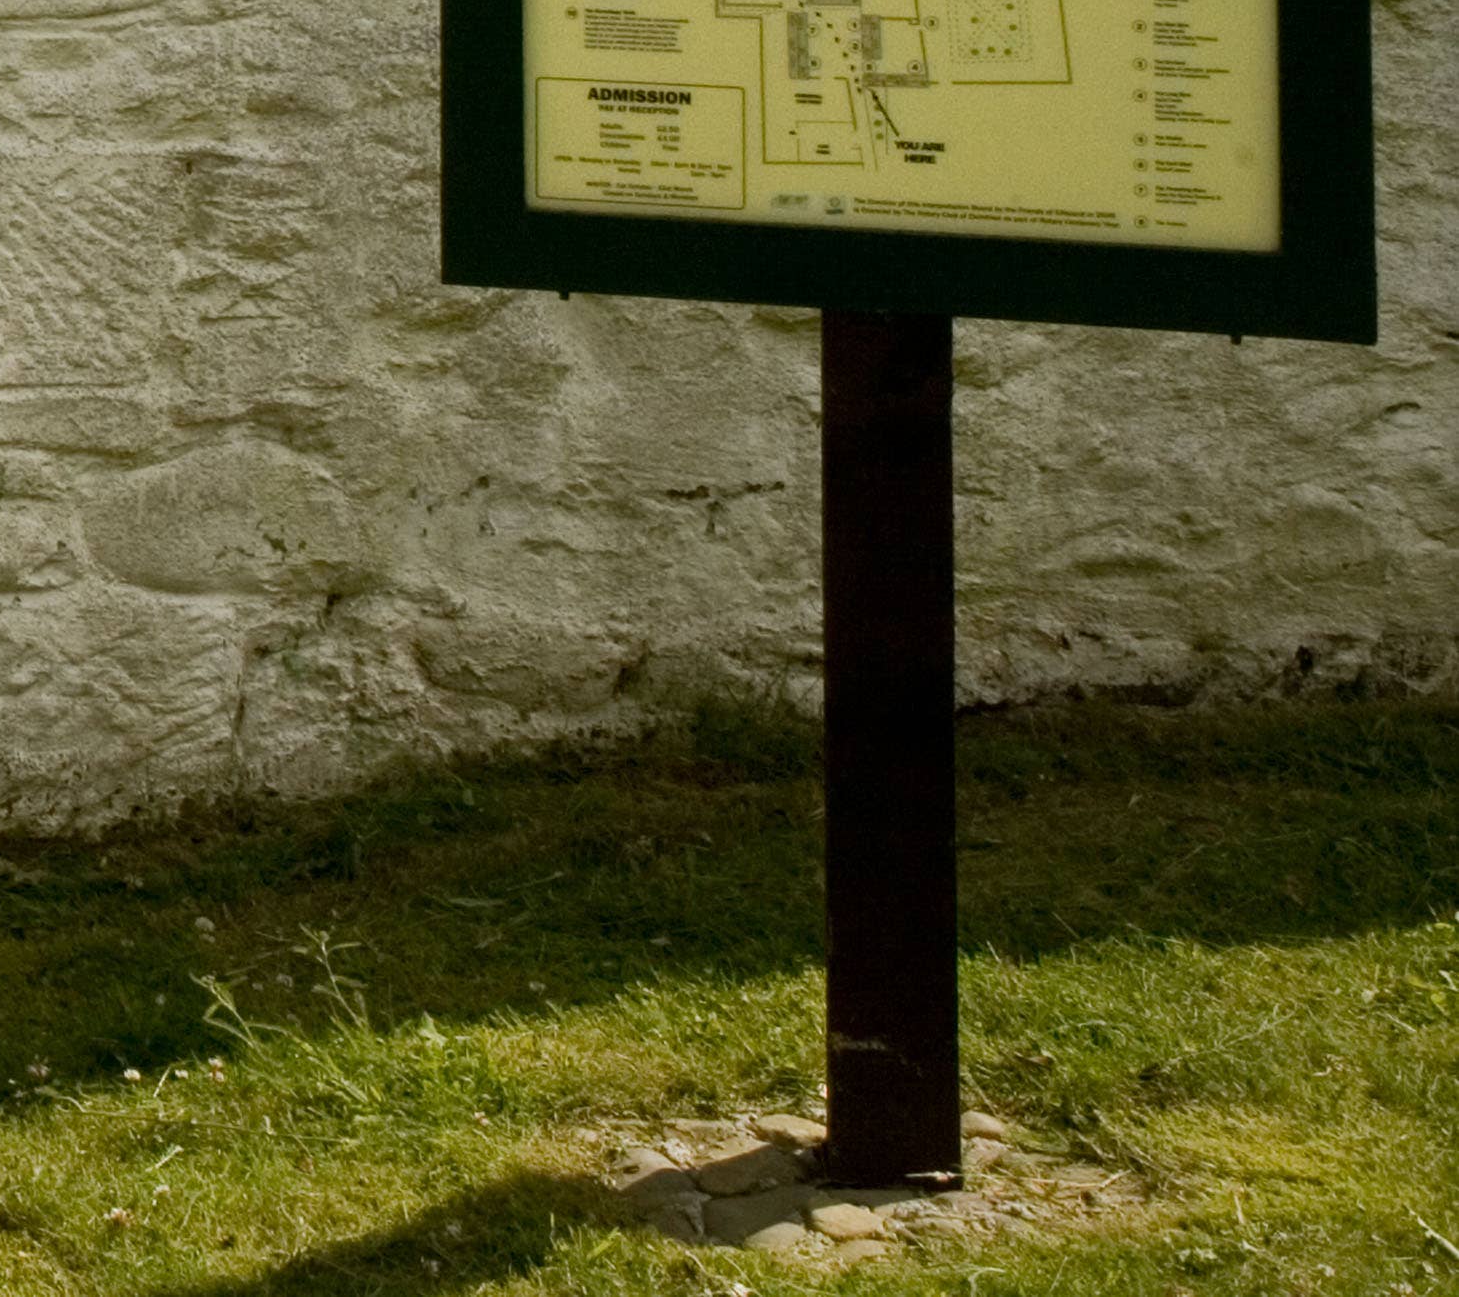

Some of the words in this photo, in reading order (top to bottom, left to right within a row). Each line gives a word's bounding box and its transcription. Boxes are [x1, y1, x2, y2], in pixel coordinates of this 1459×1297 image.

[588, 87, 692, 104] ADMISSION
[894, 140, 920, 151] YOU
[921, 142, 945, 153] ARE
[904, 154, 936, 164] HERE
